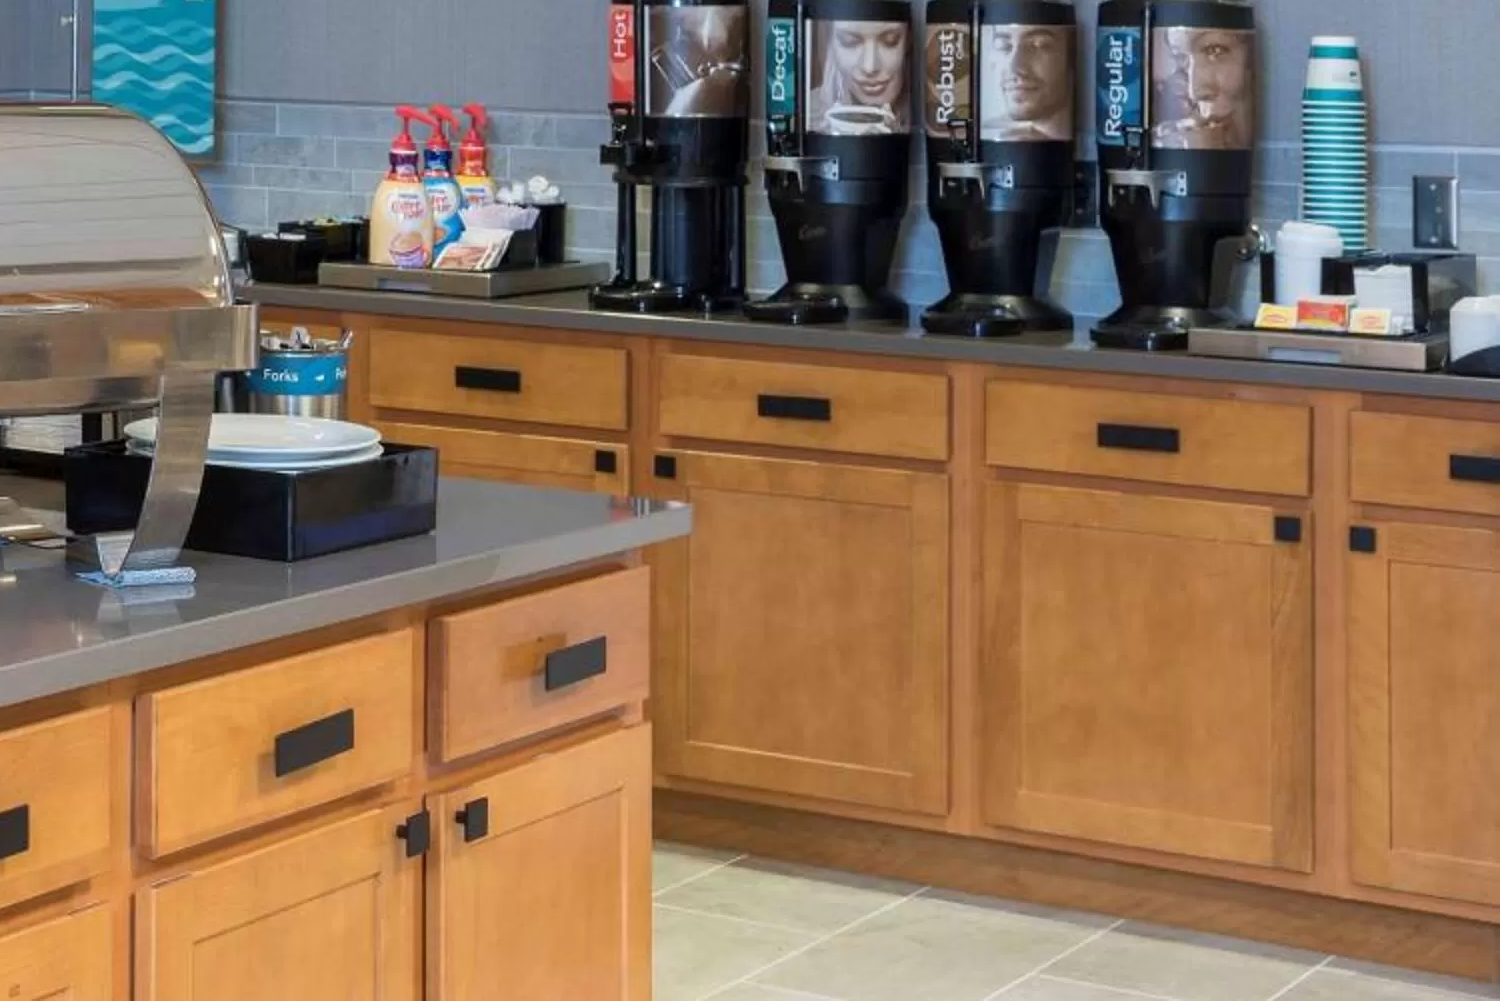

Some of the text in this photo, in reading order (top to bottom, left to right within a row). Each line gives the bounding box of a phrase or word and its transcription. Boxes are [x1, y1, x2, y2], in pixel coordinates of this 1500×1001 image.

[612, 10, 628, 58] Hot
[771, 24, 787, 101] Decaf
[935, 30, 955, 124] Robust
[1104, 35, 1129, 137] Regular
[262, 367, 300, 383] Forks
